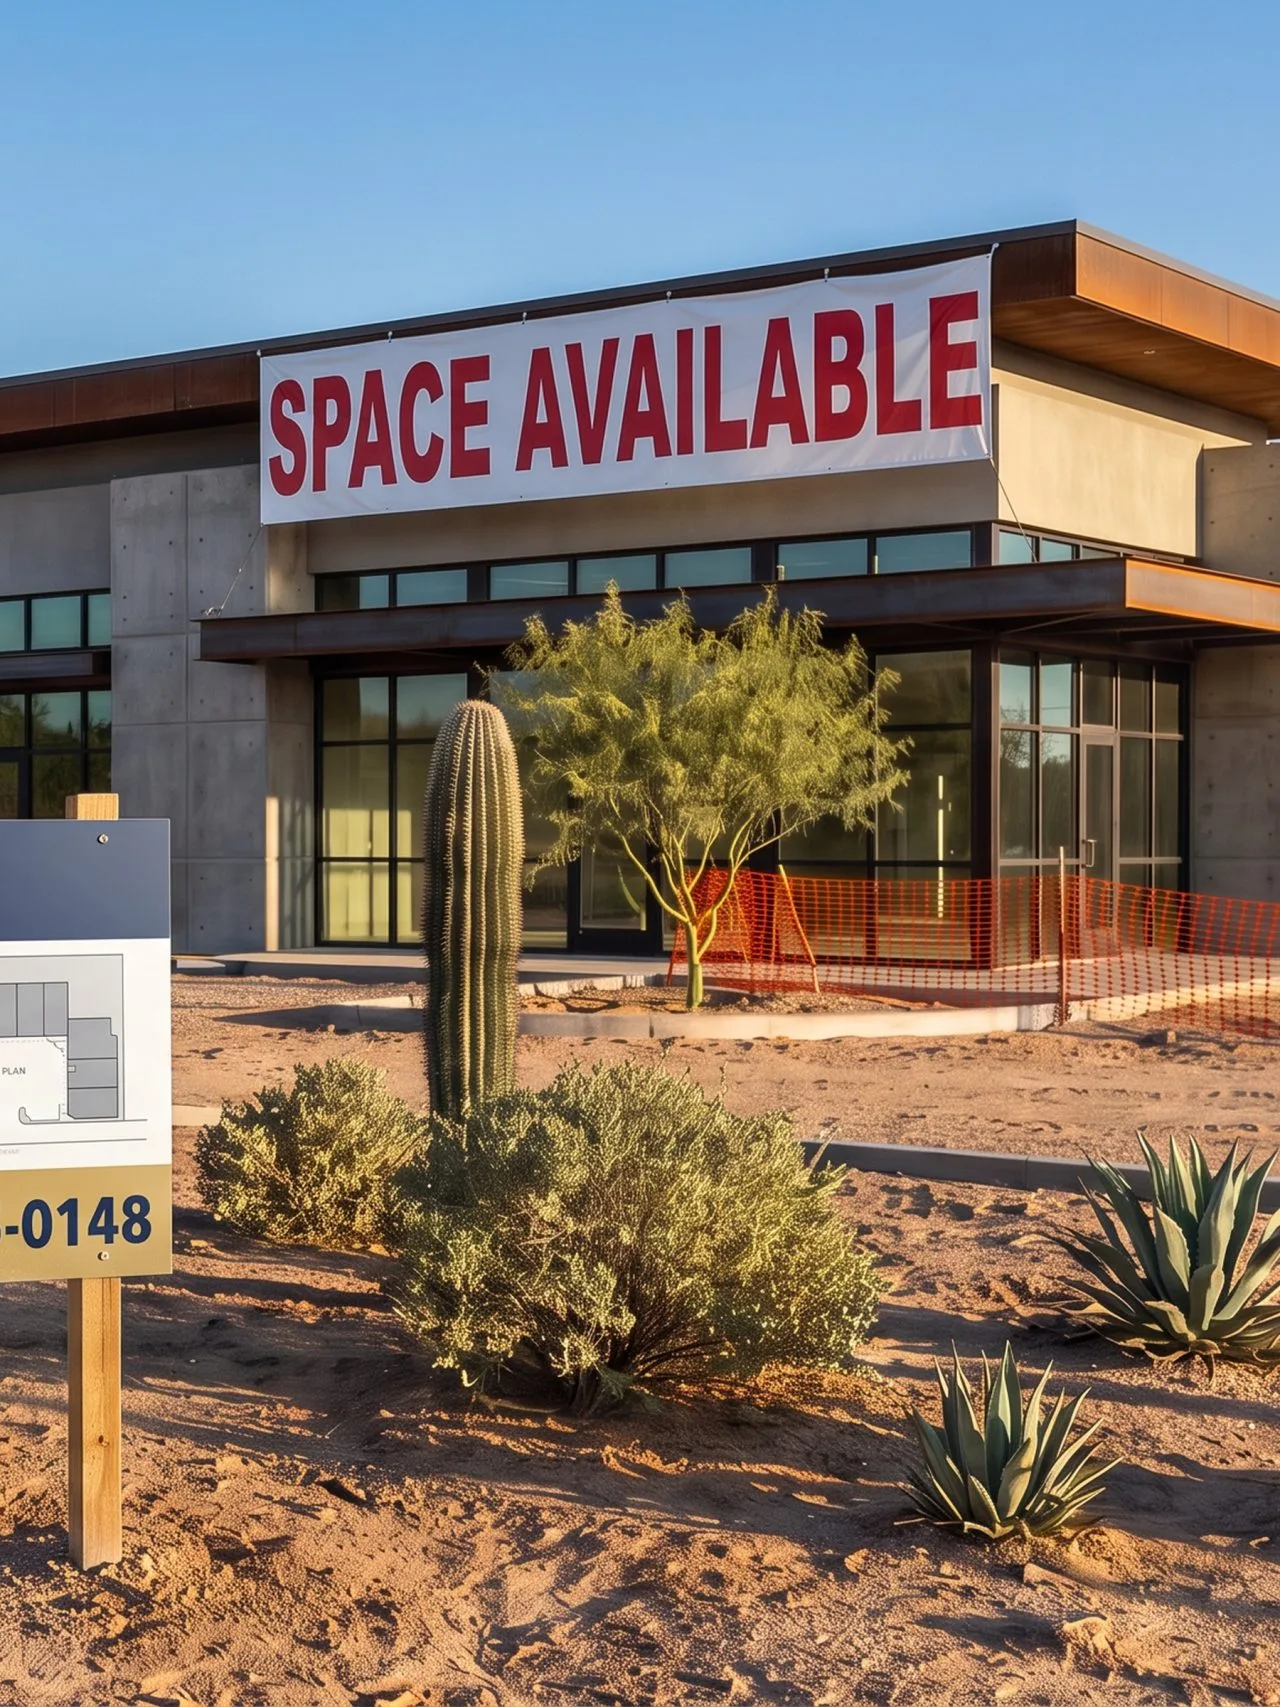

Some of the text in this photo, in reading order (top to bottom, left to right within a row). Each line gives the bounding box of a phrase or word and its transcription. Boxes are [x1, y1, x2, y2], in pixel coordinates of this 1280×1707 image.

[268, 290, 983, 496] SPACE AVAILABLE
[2, 1066, 26, 1075] PLAN
